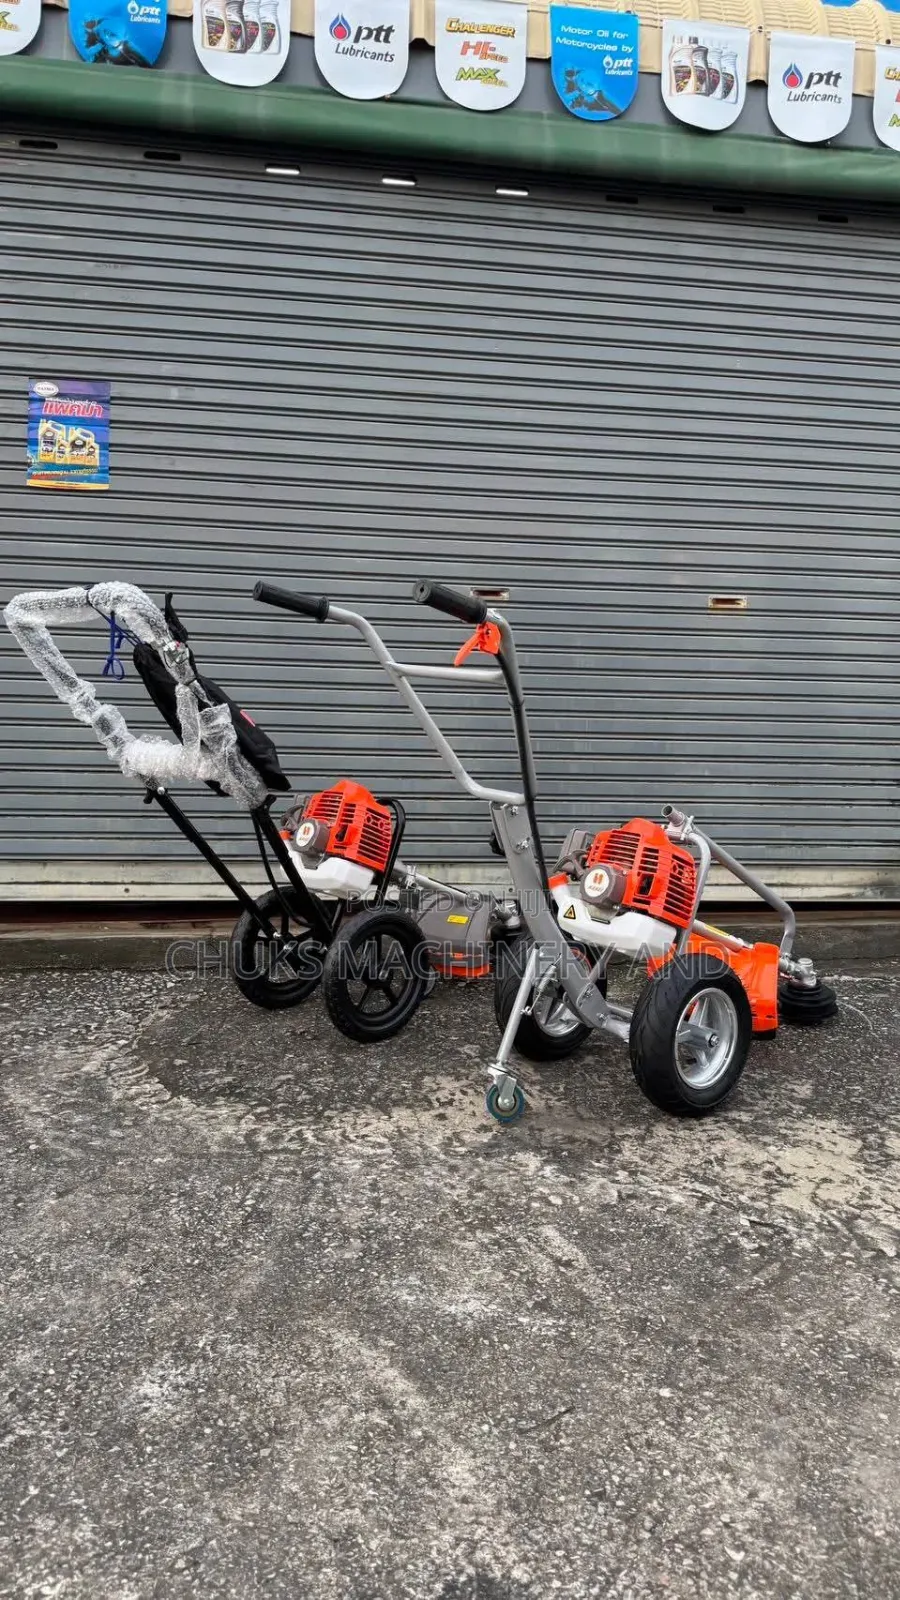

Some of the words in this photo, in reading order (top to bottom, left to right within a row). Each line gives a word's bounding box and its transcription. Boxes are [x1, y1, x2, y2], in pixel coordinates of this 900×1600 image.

[130, 15, 161, 24] Lubricants
[353, 24, 395, 44] ptt
[560, 25, 593, 36] Motor
[596, 29, 609, 38] Oil
[613, 31, 629, 40] for
[555, 36, 618, 52] Motorcycles
[621, 44, 634, 53] by
[335, 43, 395, 62] Lubricants
[613, 58, 633, 68] ptt
[456, 66, 500, 80] MAX
[605, 68, 633, 76] Lubricants
[804, 70, 842, 89] ptt
[786, 91, 842, 104] Lubricants
